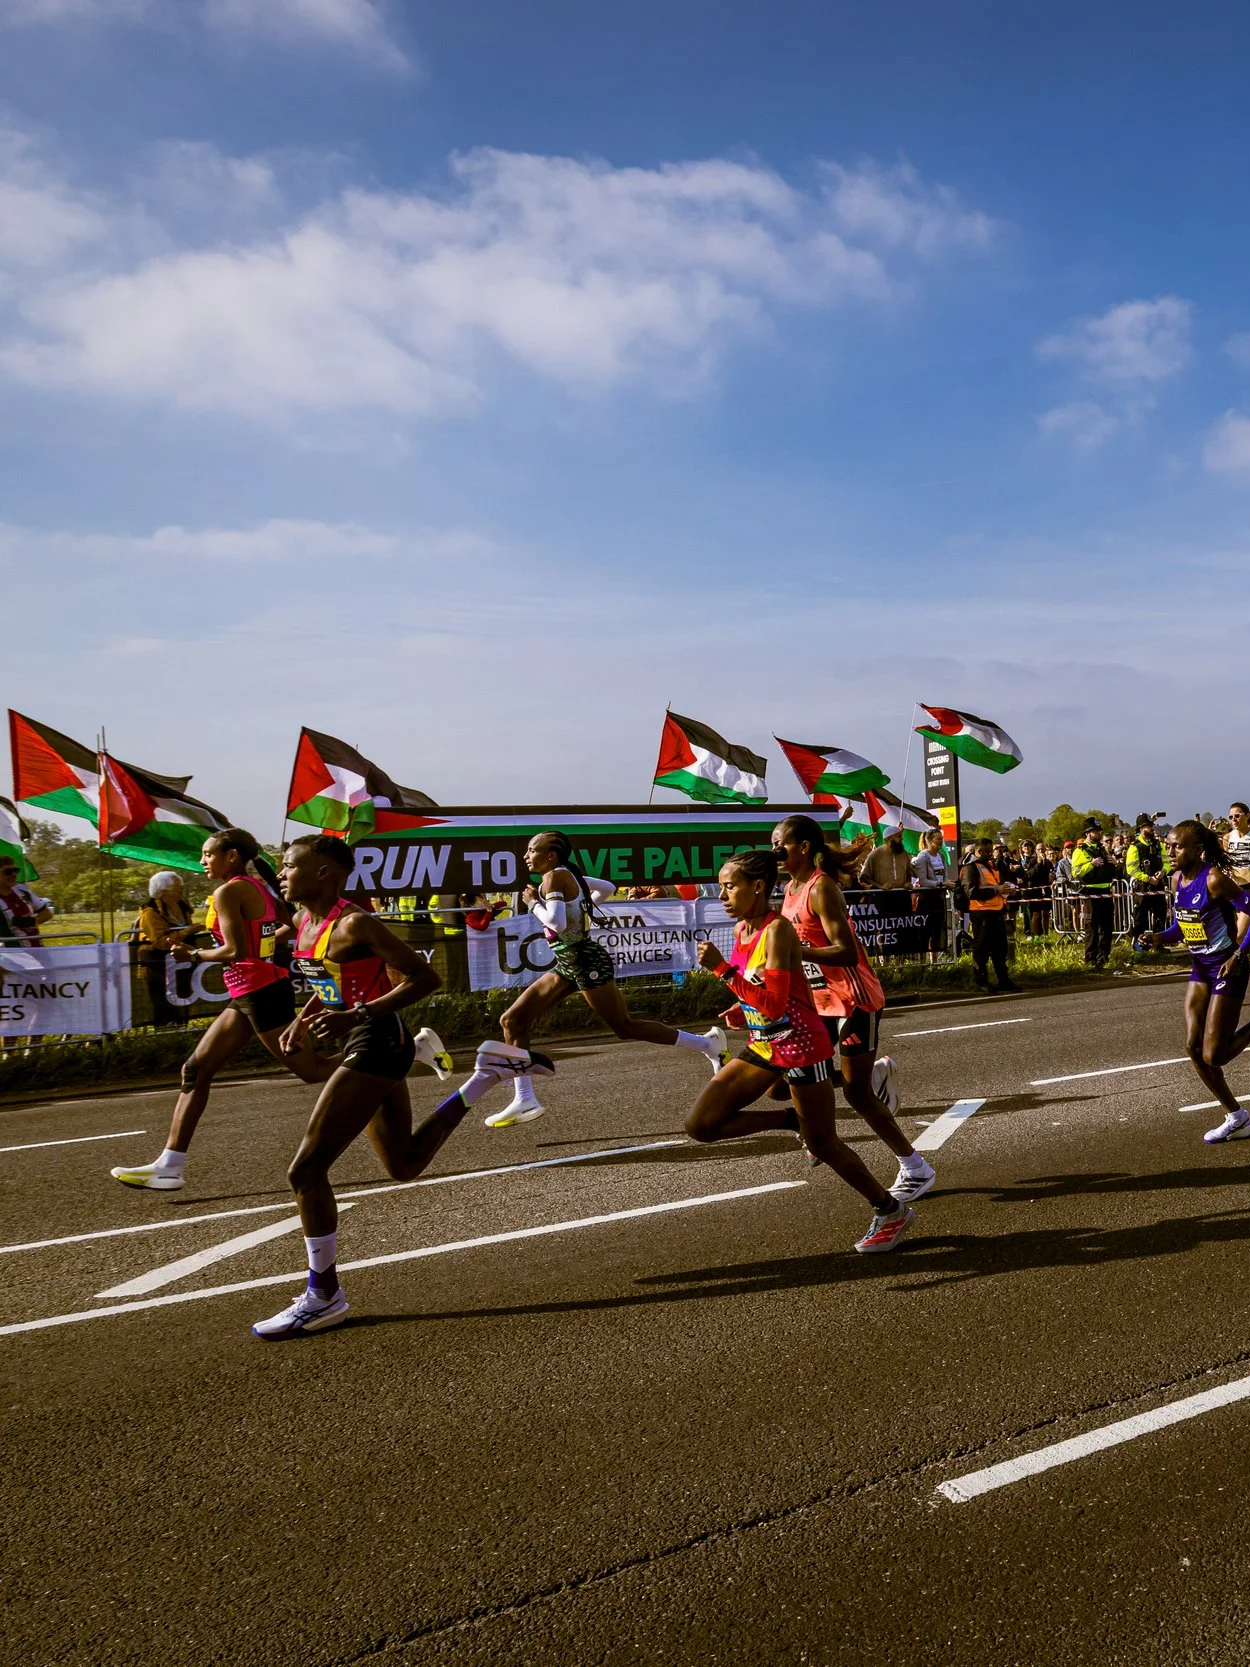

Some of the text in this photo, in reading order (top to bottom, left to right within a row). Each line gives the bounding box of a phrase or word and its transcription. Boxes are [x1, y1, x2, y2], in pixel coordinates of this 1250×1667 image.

[345, 845, 452, 891] RUN
[463, 851, 516, 886] TO
[851, 914, 929, 932] ONSULTANCY
[597, 928, 713, 949] CONSULTANCY
[497, 926, 558, 975] tc
[608, 948, 673, 966] ERVICES
[326, 985, 339, 1001] 2
